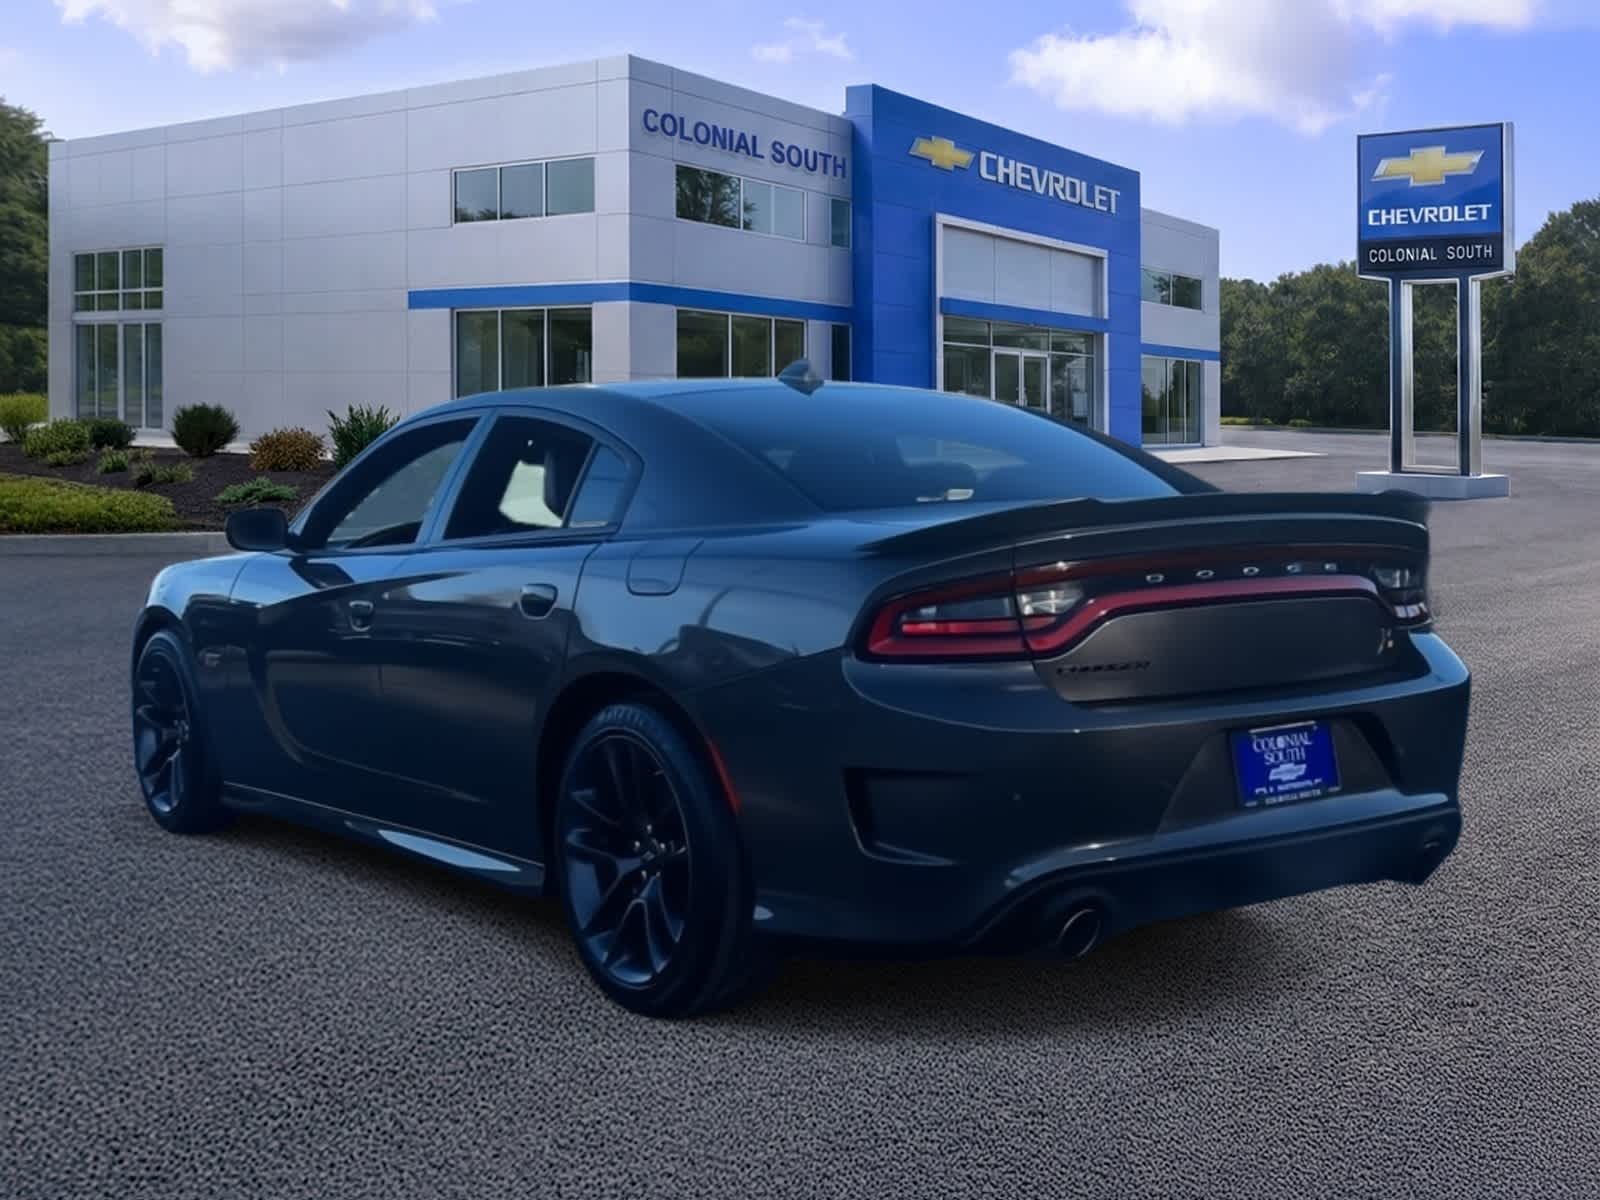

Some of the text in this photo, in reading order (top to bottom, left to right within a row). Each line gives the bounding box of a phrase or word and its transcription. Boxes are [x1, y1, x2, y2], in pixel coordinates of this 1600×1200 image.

[643, 108, 847, 179] COLONIAL SOUTH
[979, 150, 1121, 214] CHEVROLET
[1368, 204, 1492, 226] CHEVROLET
[1369, 244, 1493, 263] COLONIAL SOUTH
[1252, 731, 1312, 752] COLONIAL
[1263, 747, 1306, 766] SOUTH
